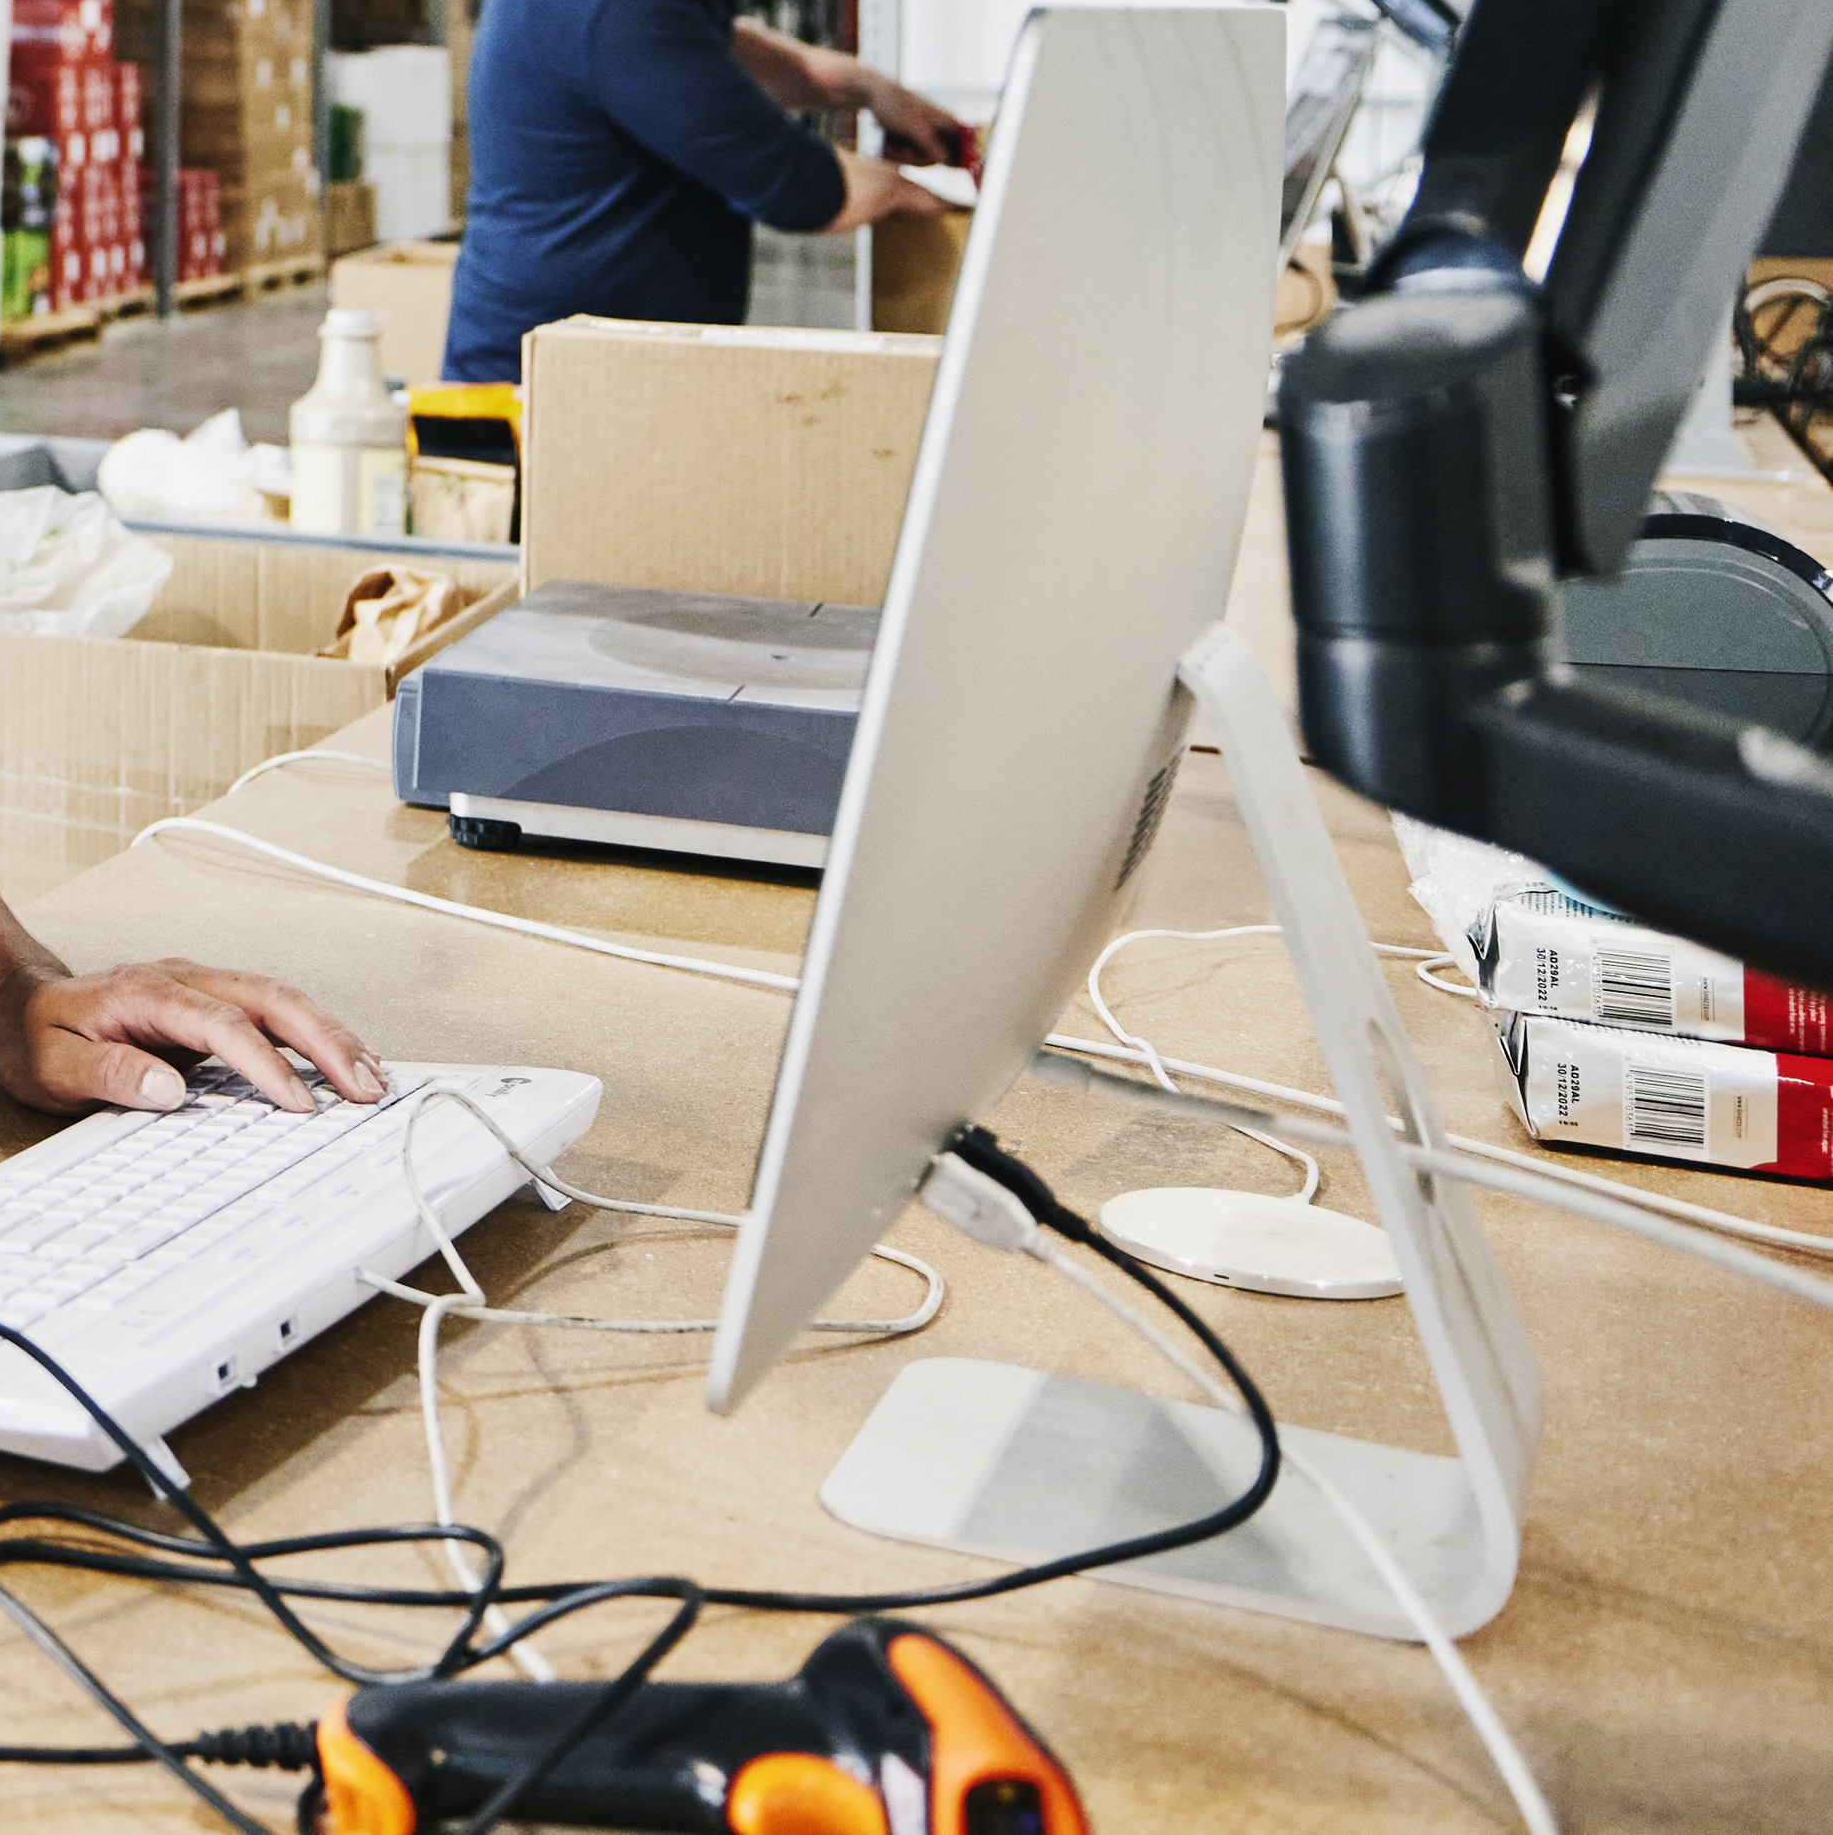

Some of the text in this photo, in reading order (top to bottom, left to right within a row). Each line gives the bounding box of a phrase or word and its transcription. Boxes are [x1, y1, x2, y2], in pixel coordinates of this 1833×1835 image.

[1536, 947, 1548, 1002] 30/12/2022
[1549, 949, 1559, 989] AD29AL
[1557, 1062, 1568, 1117] 30/12/2022
[1570, 1064, 1580, 1104] AD29AL
